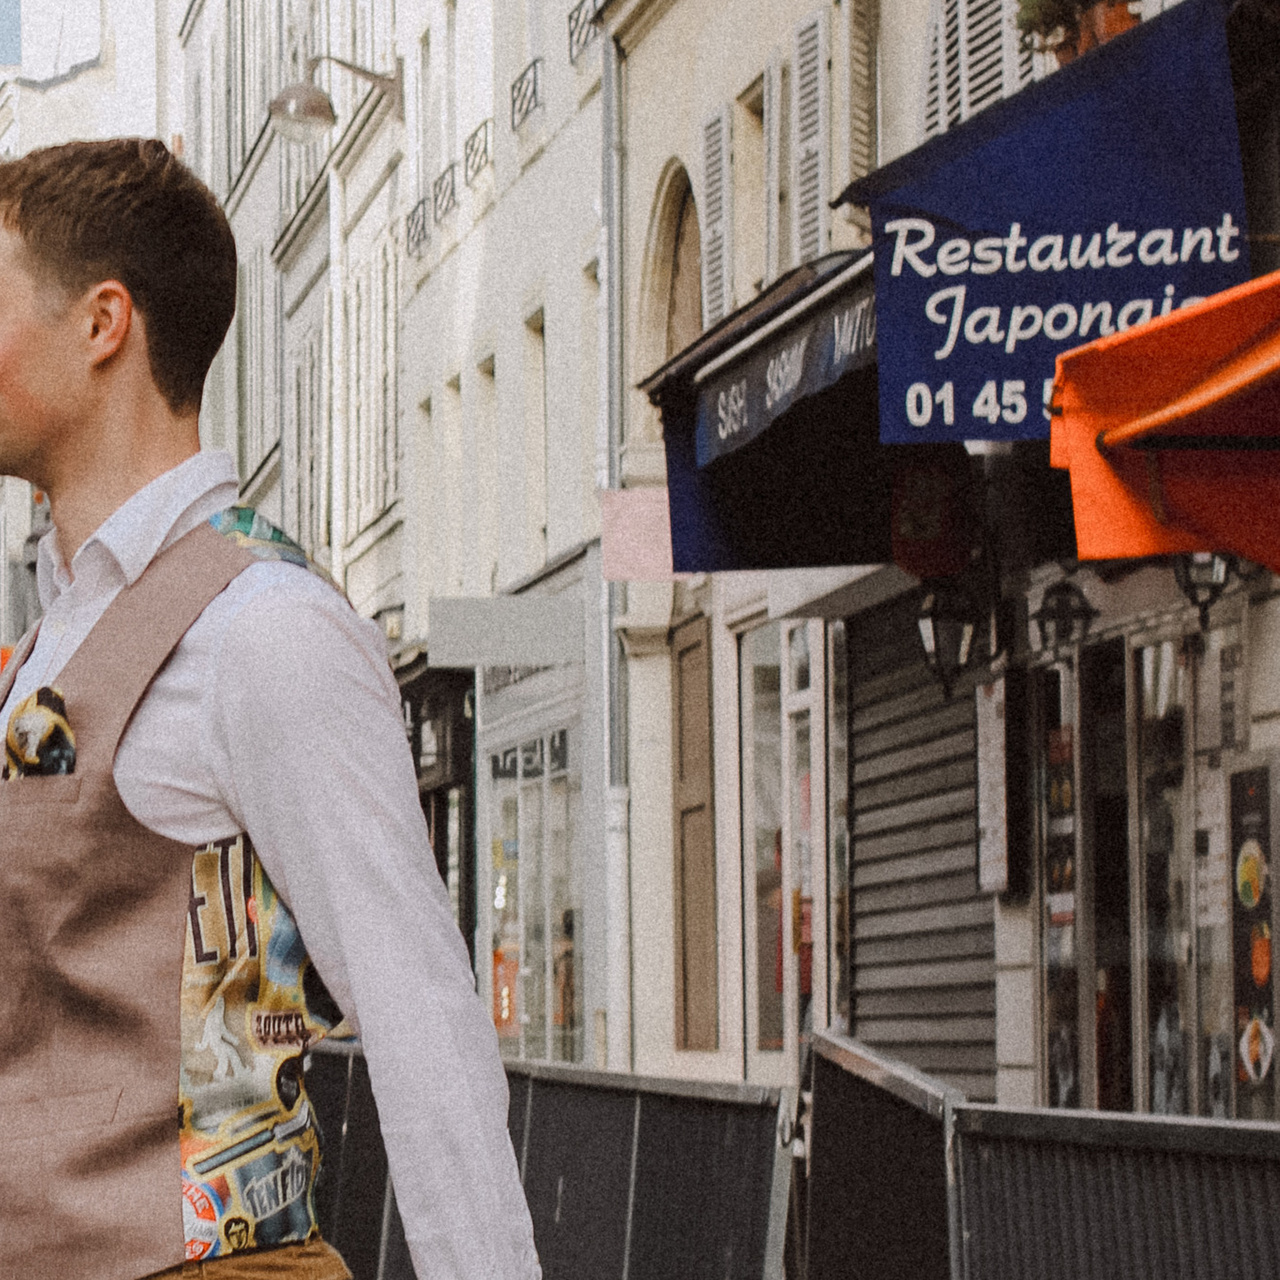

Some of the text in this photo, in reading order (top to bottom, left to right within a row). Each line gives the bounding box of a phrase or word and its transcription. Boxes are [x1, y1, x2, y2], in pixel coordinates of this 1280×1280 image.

[884, 213, 1240, 277] Restaurant
[925, 284, 1208, 360] Japonai
[905, 381, 955, 427] 01
[972, 379, 1028, 424] 45
